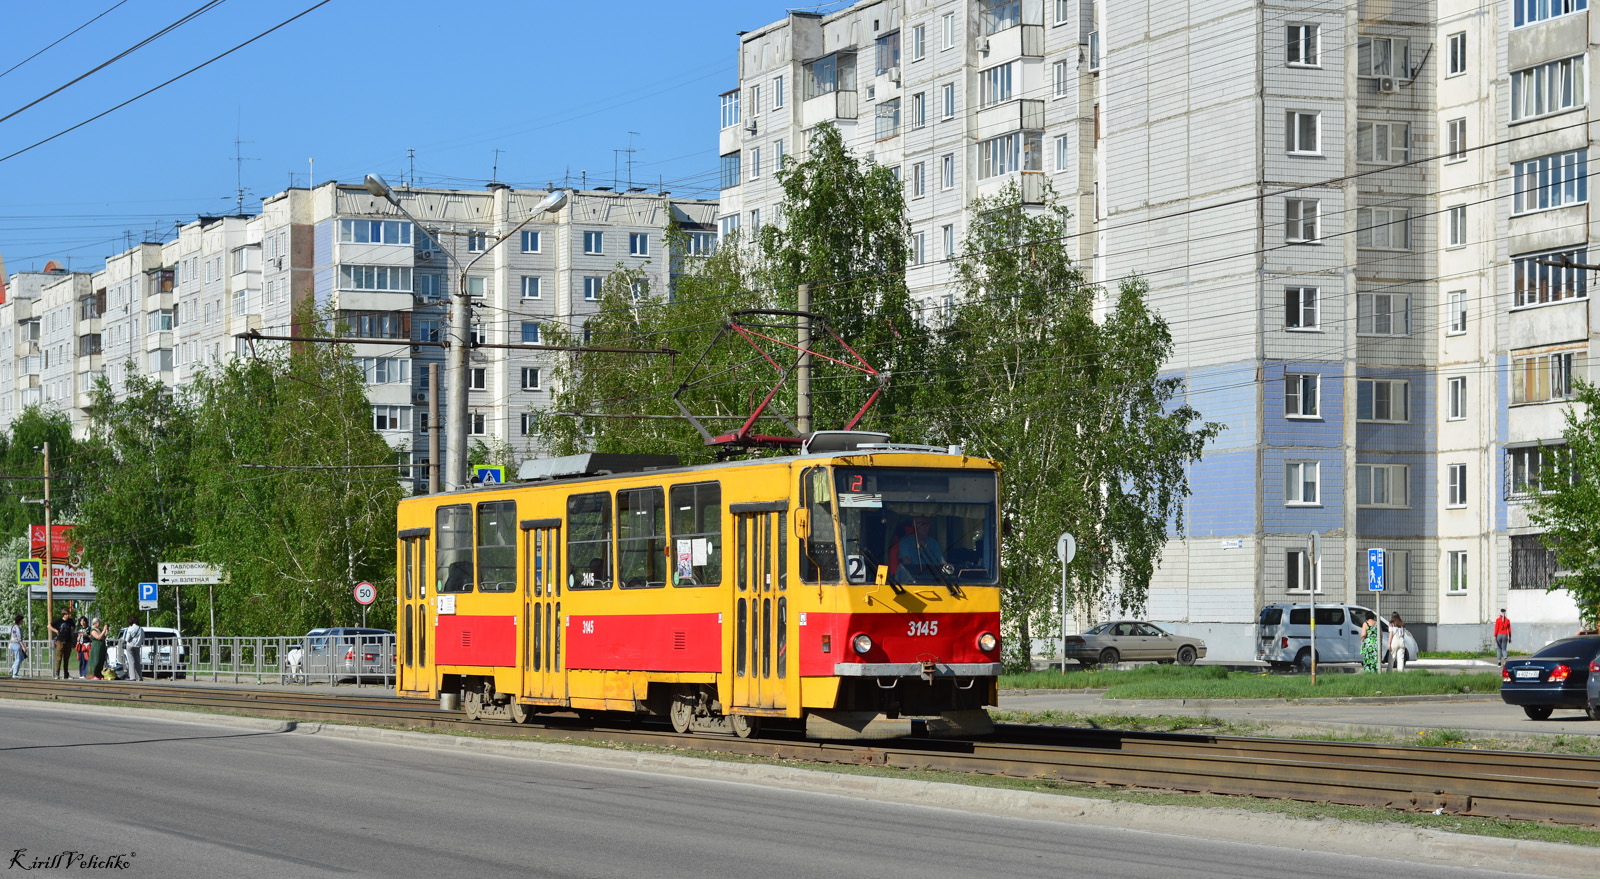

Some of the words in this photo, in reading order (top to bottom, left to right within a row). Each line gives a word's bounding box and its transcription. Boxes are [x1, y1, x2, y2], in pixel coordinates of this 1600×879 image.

[851, 475, 863, 492] 2
[848, 558, 864, 579] 2
[52, 577, 86, 588] ОБЕДЫ!
[582, 572, 595, 587] 3145
[143, 585, 154, 600] P
[359, 588, 371, 598] 50
[582, 620, 594, 634] 3145
[907, 620, 938, 636] 3145
